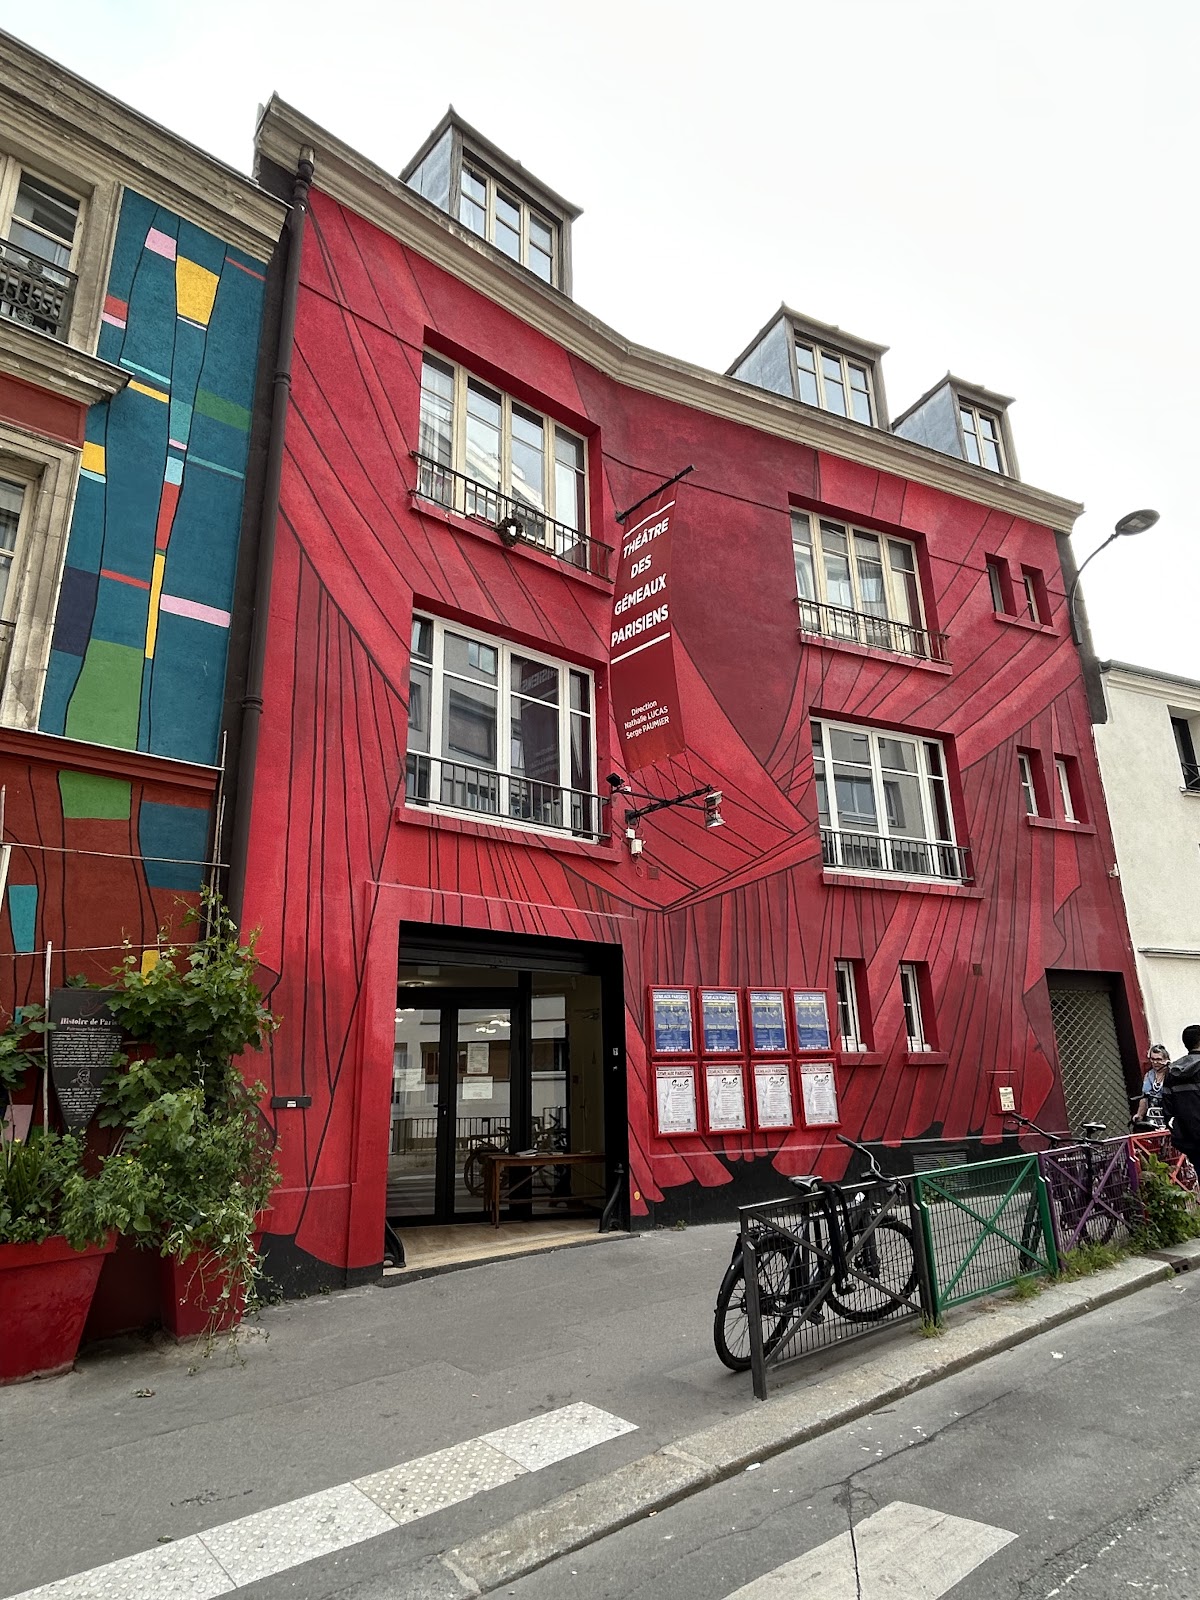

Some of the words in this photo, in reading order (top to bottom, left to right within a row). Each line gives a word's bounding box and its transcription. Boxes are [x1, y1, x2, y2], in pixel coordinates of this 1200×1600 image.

[623, 517, 670, 559] THÉÂTRE
[630, 554, 652, 579] DES
[614, 573, 667, 616] GÉMEAUX
[610, 604, 669, 648] PARISIENS
[624, 714, 648, 730] Nathalie
[647, 705, 669, 720] LUCAS
[631, 700, 658, 717] Direction
[625, 727, 643, 740] Serge
[642, 715, 670, 733] PAUMIER
[60, 1017, 89, 1025] Histoire
